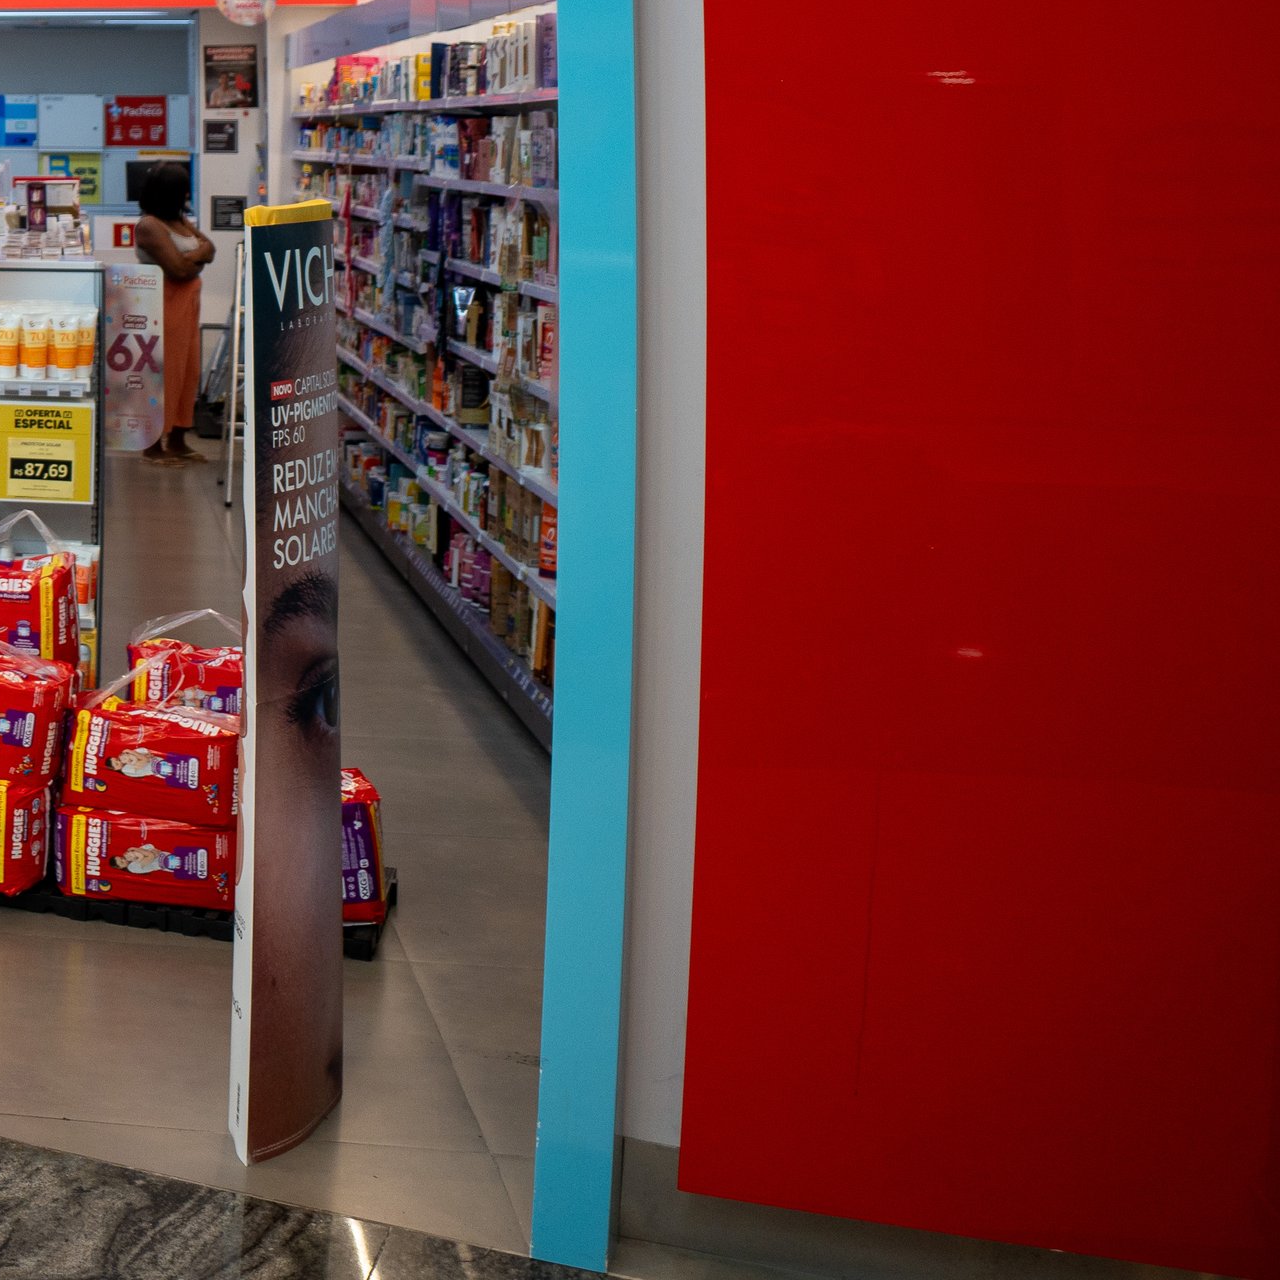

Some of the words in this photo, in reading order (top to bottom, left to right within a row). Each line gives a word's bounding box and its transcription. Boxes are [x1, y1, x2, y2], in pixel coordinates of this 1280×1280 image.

[121, 105, 164, 117] Pacheco
[123, 275, 157, 286] Pacheco
[264, 243, 335, 313] VICH
[0, 331, 15, 340] 70
[31, 332, 46, 342] 70
[60, 333, 75, 343] 70
[106, 333, 160, 374] 6X
[273, 384, 292, 396] NOVO
[294, 372, 322, 396] CAPITAL
[14, 418, 73, 430] ESPECIAL
[25, 409, 62, 418] OFERTA
[271, 392, 331, 428] UV-PIGMENT
[272, 428, 290, 448] FPS
[292, 425, 306, 444] 60
[14, 468, 23, 476] R$
[24, 463, 68, 479] 87,69
[273, 452, 325, 495] REDUZ
[273, 520, 337, 570] SOLARES
[58, 595, 67, 645] HUGGIES
[40, 721, 57, 775] HUGGIES
[84, 716, 104, 775] HUGGIES
[11, 808, 24, 859] HUGGIES
[87, 817, 101, 876] HUGGIES
